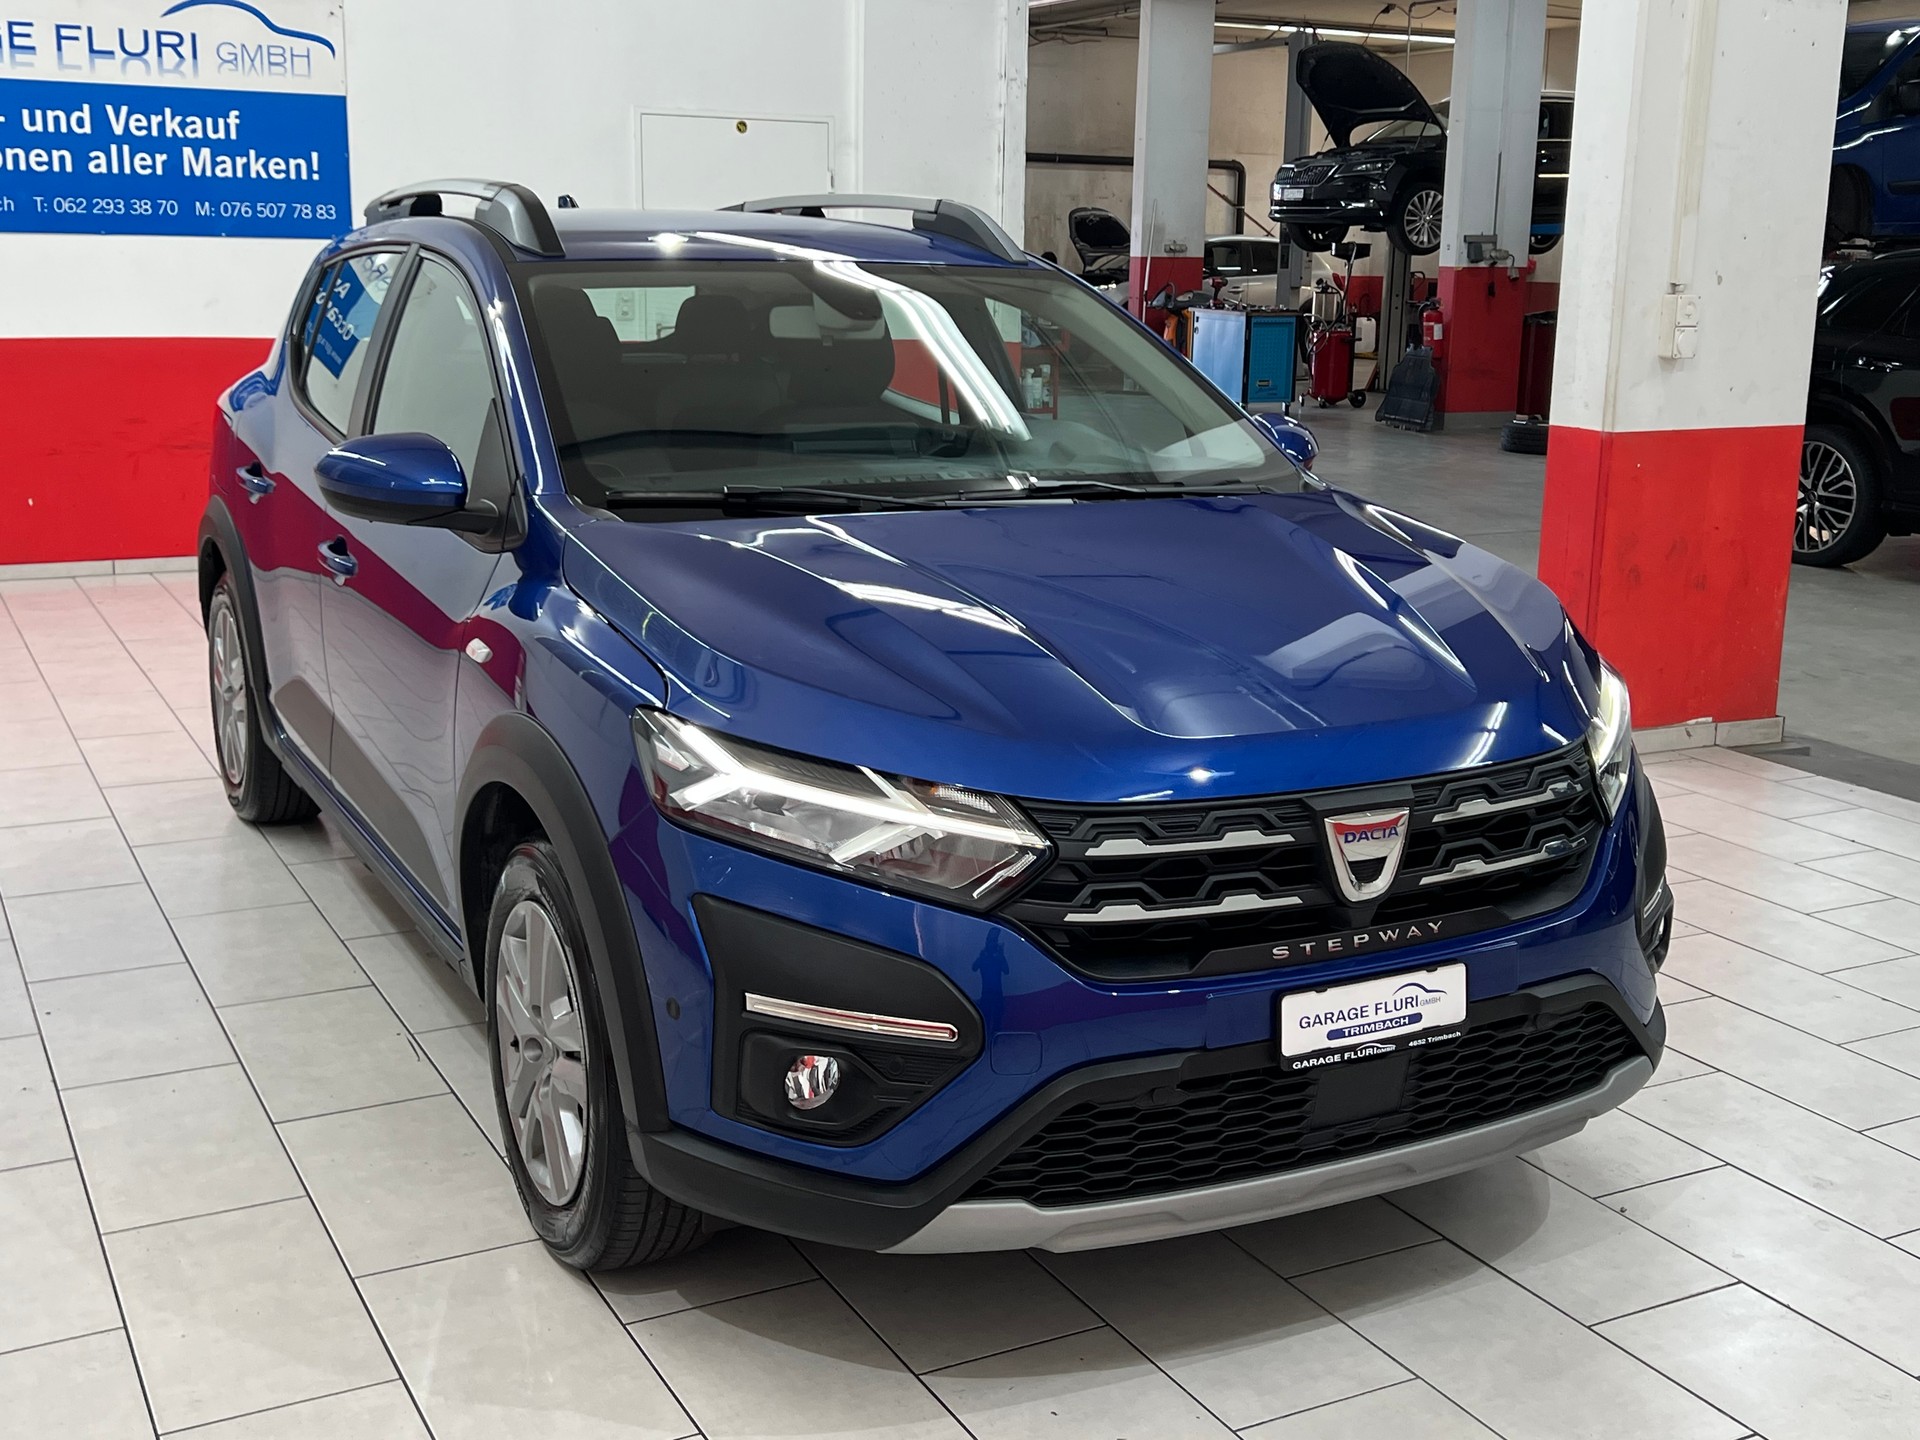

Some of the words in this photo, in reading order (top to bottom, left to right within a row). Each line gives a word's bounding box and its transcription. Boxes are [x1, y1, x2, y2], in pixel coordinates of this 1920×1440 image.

[54, 23, 199, 60] FLURI
[215, 41, 312, 66] GMBH
[21, 103, 92, 135] und
[104, 103, 240, 140] Verkauf
[0, 147, 73, 172] nen
[88, 143, 168, 175] aller
[182, 146, 320, 180] Marken!
[33, 196, 48, 213] T:
[53, 197, 87, 213] 062
[92, 198, 125, 215] 293
[129, 199, 152, 216] 38
[157, 199, 179, 216] 70
[195, 201, 216, 216] M:
[220, 201, 252, 218] 076
[256, 202, 287, 219] 507
[291, 203, 312, 219] 78
[316, 204, 337, 220] 83
[1344, 826, 1400, 844] DACIA
[1272, 920, 1443, 959] STEPWAY
[1299, 1004, 1370, 1029] GARAGE
[1374, 994, 1419, 1015] FLURI
[1419, 996, 1441, 1007] GMBH
[1342, 1016, 1409, 1037] TRIMBACH
[1427, 1031, 1461, 1043] Trimbach
[1292, 1053, 1342, 1070] GARAGE
[1344, 1046, 1377, 1060] FLURI
